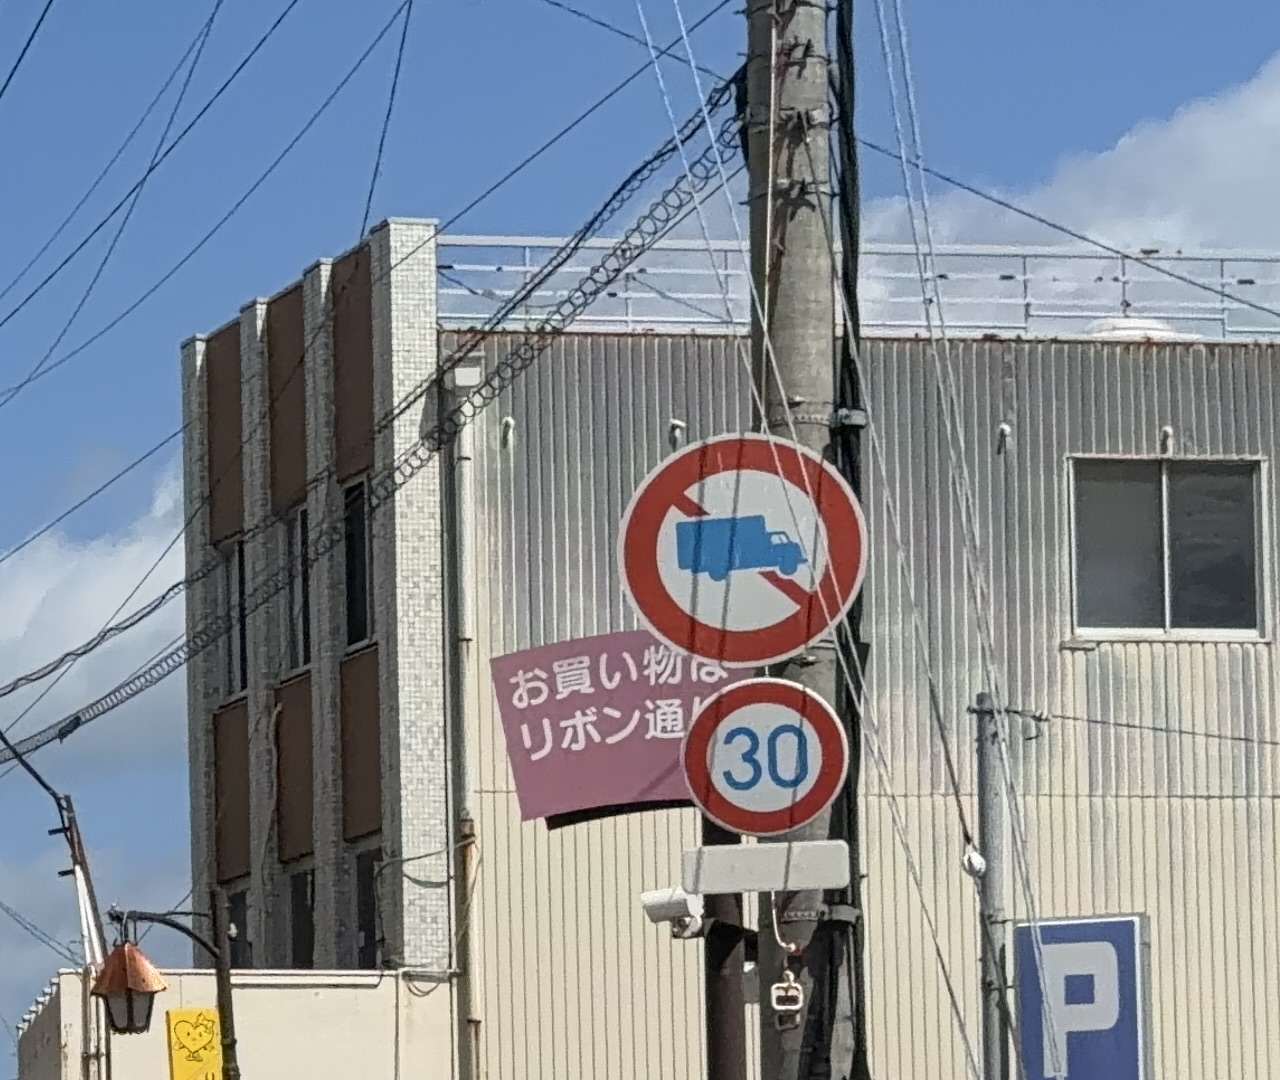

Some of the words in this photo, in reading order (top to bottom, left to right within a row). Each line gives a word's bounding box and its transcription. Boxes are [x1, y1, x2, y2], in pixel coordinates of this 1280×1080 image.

[510, 645, 728, 710] お買い物は
[521, 695, 705, 762] リボン通
[722, 724, 809, 791] 30
[1041, 941, 1120, 1079] P
